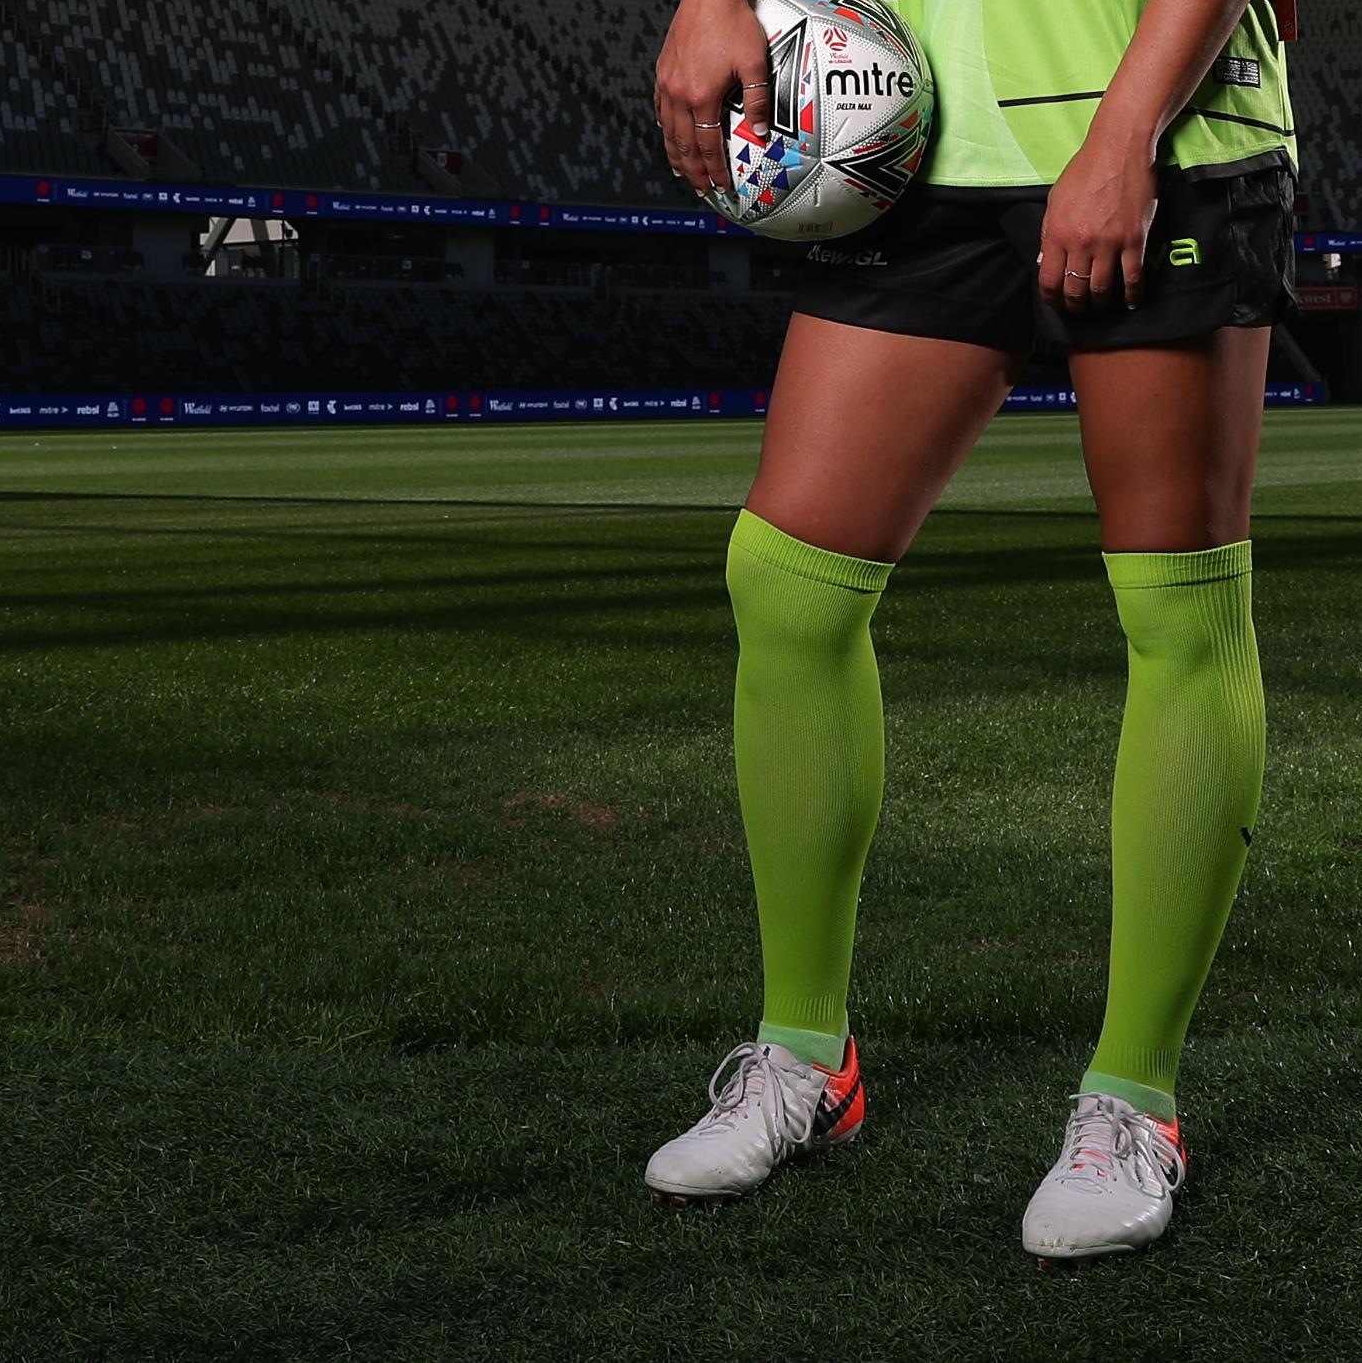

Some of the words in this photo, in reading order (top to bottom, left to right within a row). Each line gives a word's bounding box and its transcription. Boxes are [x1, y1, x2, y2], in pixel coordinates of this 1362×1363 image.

[825, 62, 914, 98] mitre
[836, 102, 856, 111] DELTA
[858, 102, 873, 111] MAX
